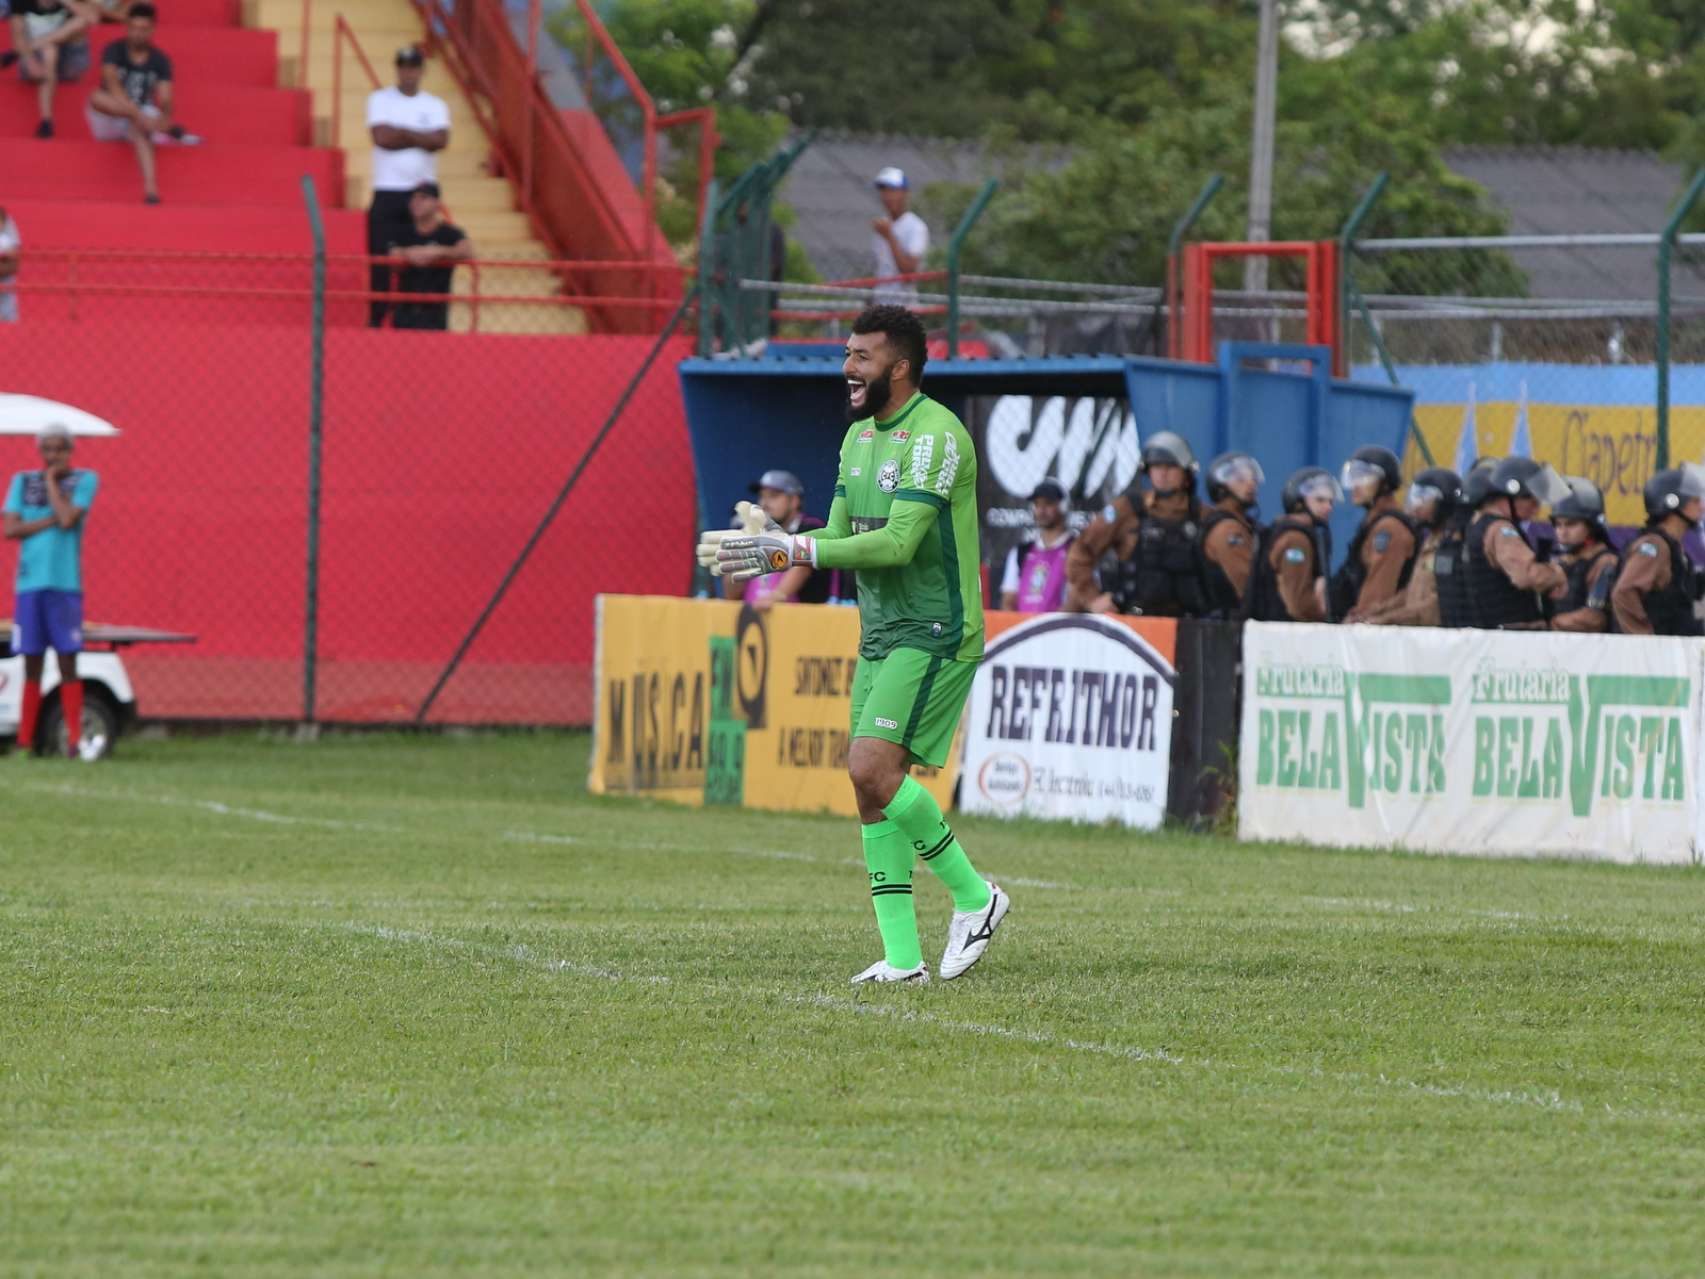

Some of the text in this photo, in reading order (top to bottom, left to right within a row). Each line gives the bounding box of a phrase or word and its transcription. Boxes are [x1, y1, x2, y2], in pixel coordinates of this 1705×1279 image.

[986, 665, 1159, 752] REFRITHOR
[1256, 673, 1452, 809] BELA VISTA
[1472, 674, 1691, 817] BELA VISTA
